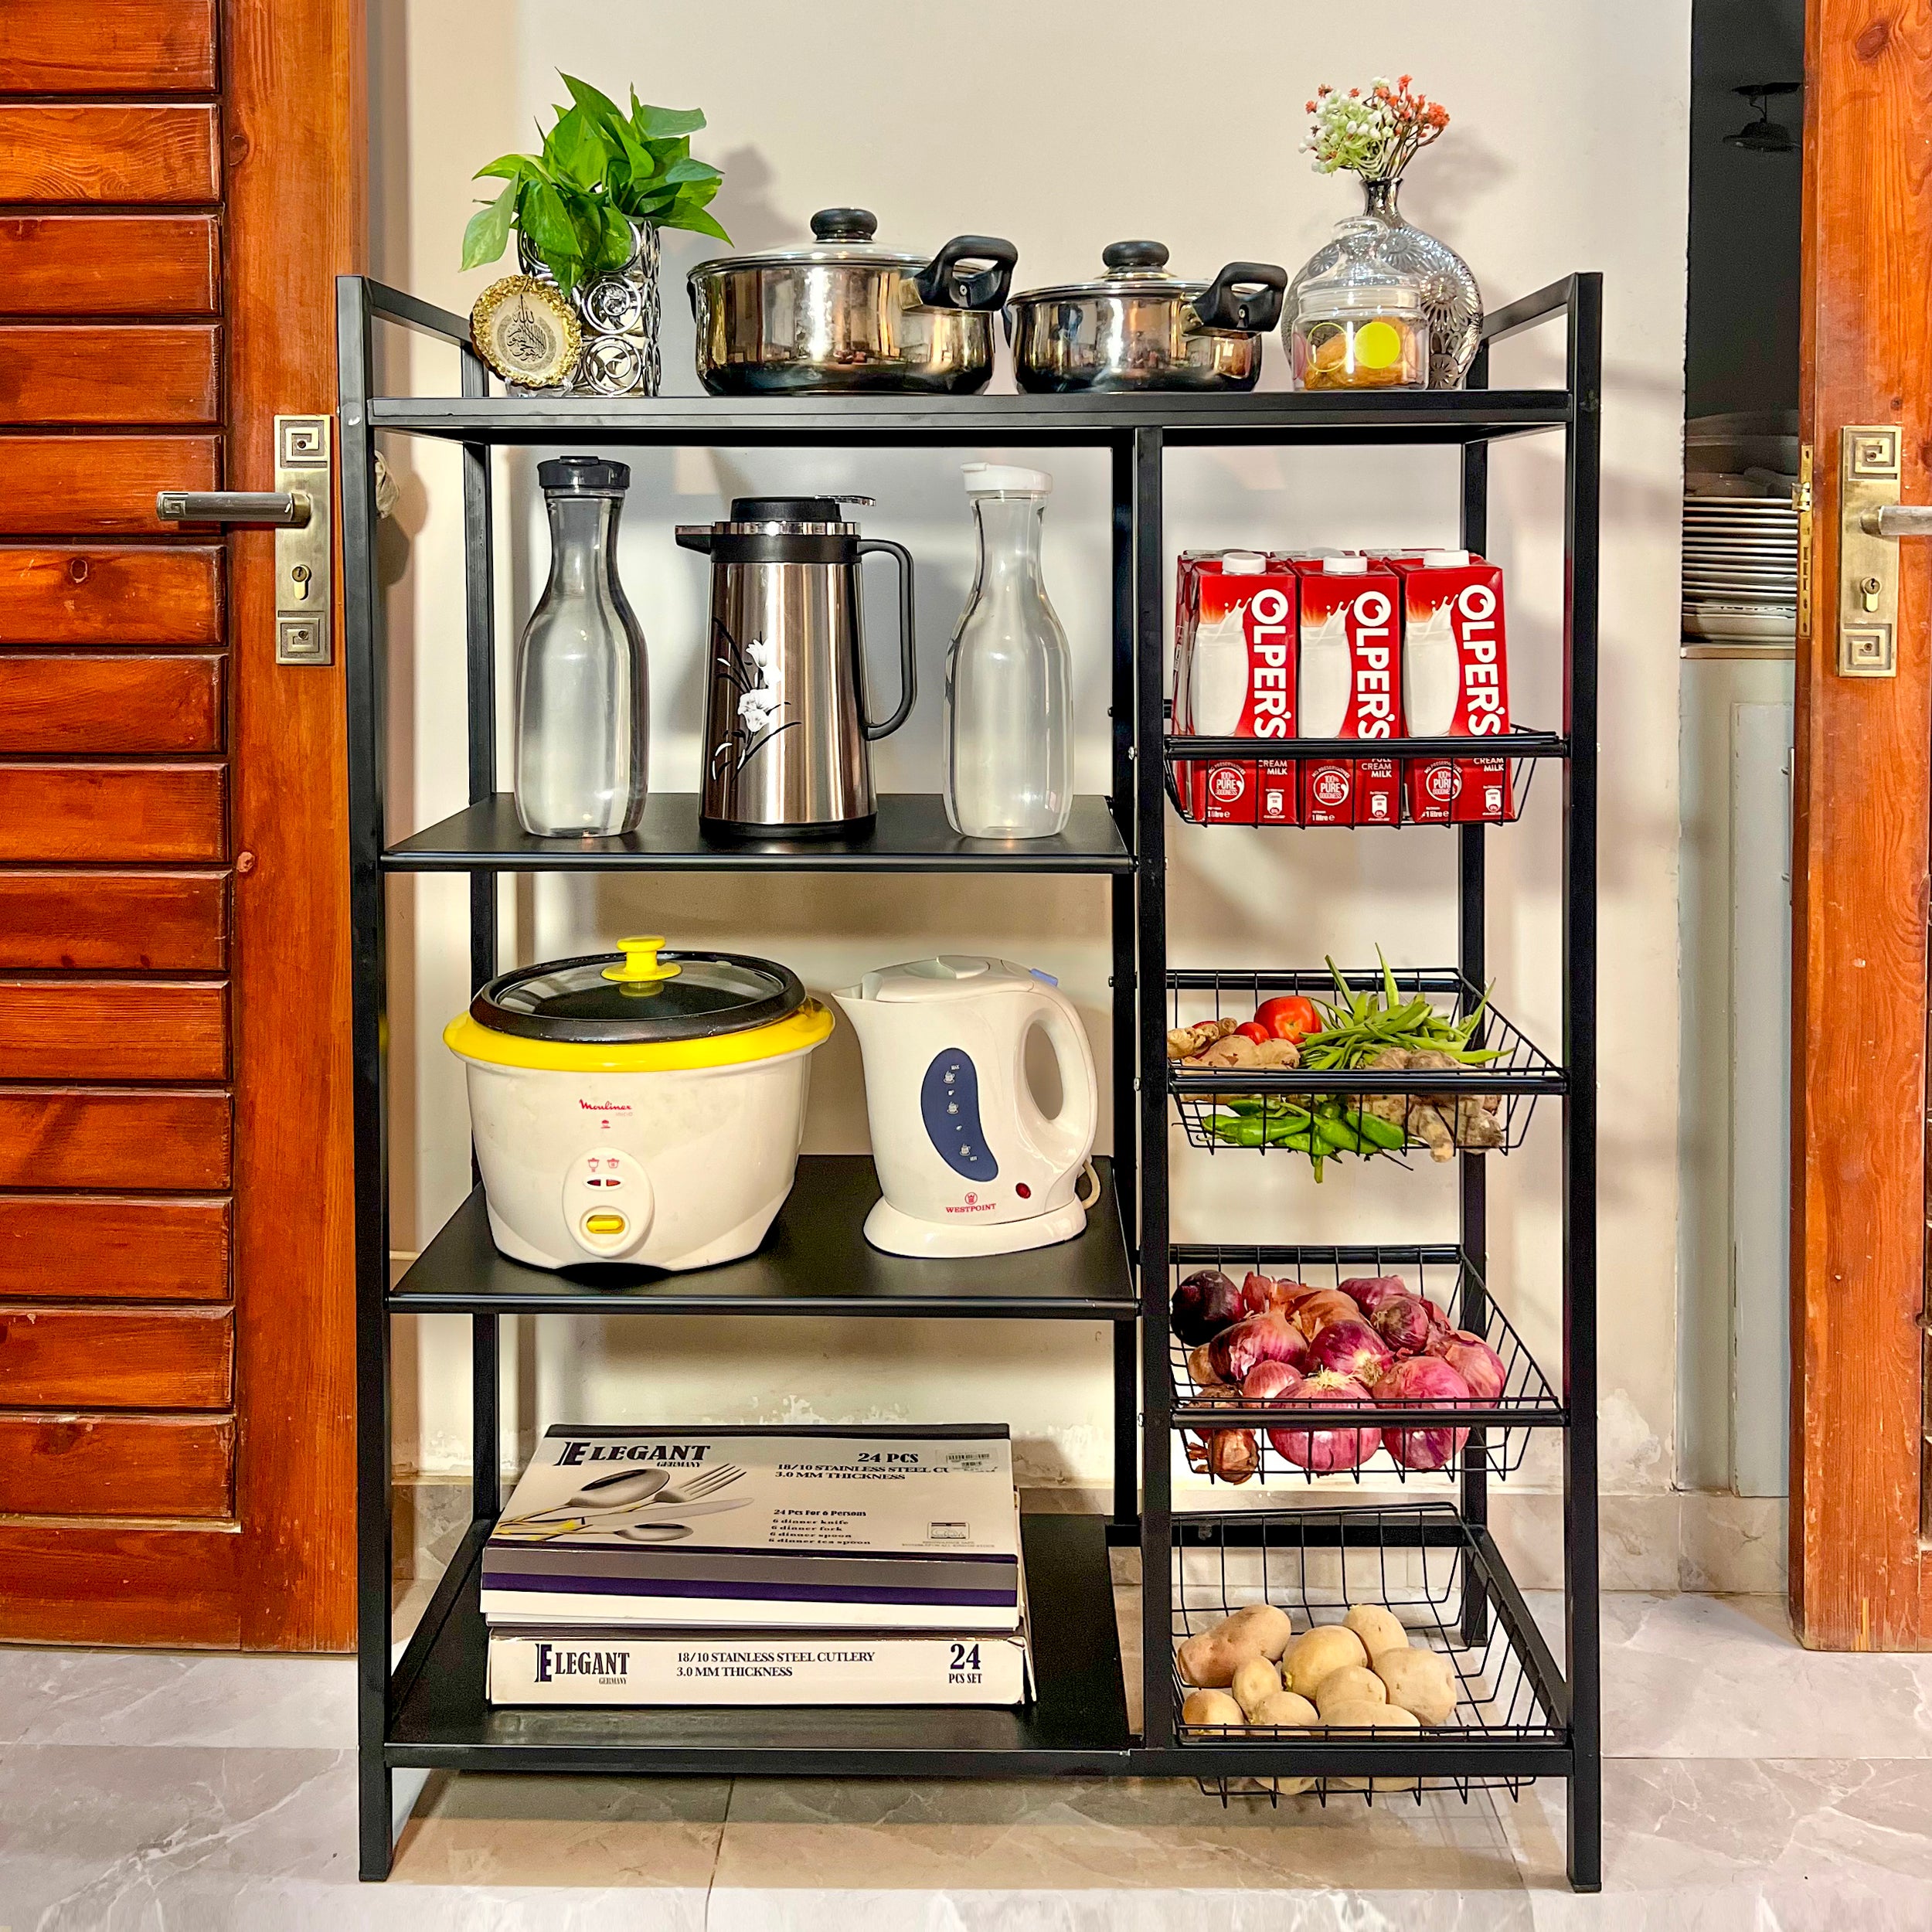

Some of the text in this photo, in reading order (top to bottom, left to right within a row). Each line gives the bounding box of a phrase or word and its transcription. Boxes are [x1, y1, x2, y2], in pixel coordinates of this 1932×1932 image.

[1251, 589, 1291, 738] OLPER'S
[1354, 591, 1395, 739] OLPER'S
[1458, 584, 1505, 736] OLPER'S
[1216, 779, 1236, 789] PURE
[1320, 782, 1341, 793] PURE
[579, 1099, 632, 1110] Moulinex
[946, 1203, 997, 1213] WESTPOINT
[553, 1441, 710, 1466] ELEGANT
[858, 1453, 919, 1464] 24 PCS
[677, 1651, 876, 1662] 18/10 STAINLESS STEEL CUTLERY
[950, 1644, 981, 1670] 24
[534, 1643, 630, 1683] ELEGANT
[676, 1666, 793, 1677] 3.0 MM THICKNESS
[948, 1673, 982, 1684] PCS SET
